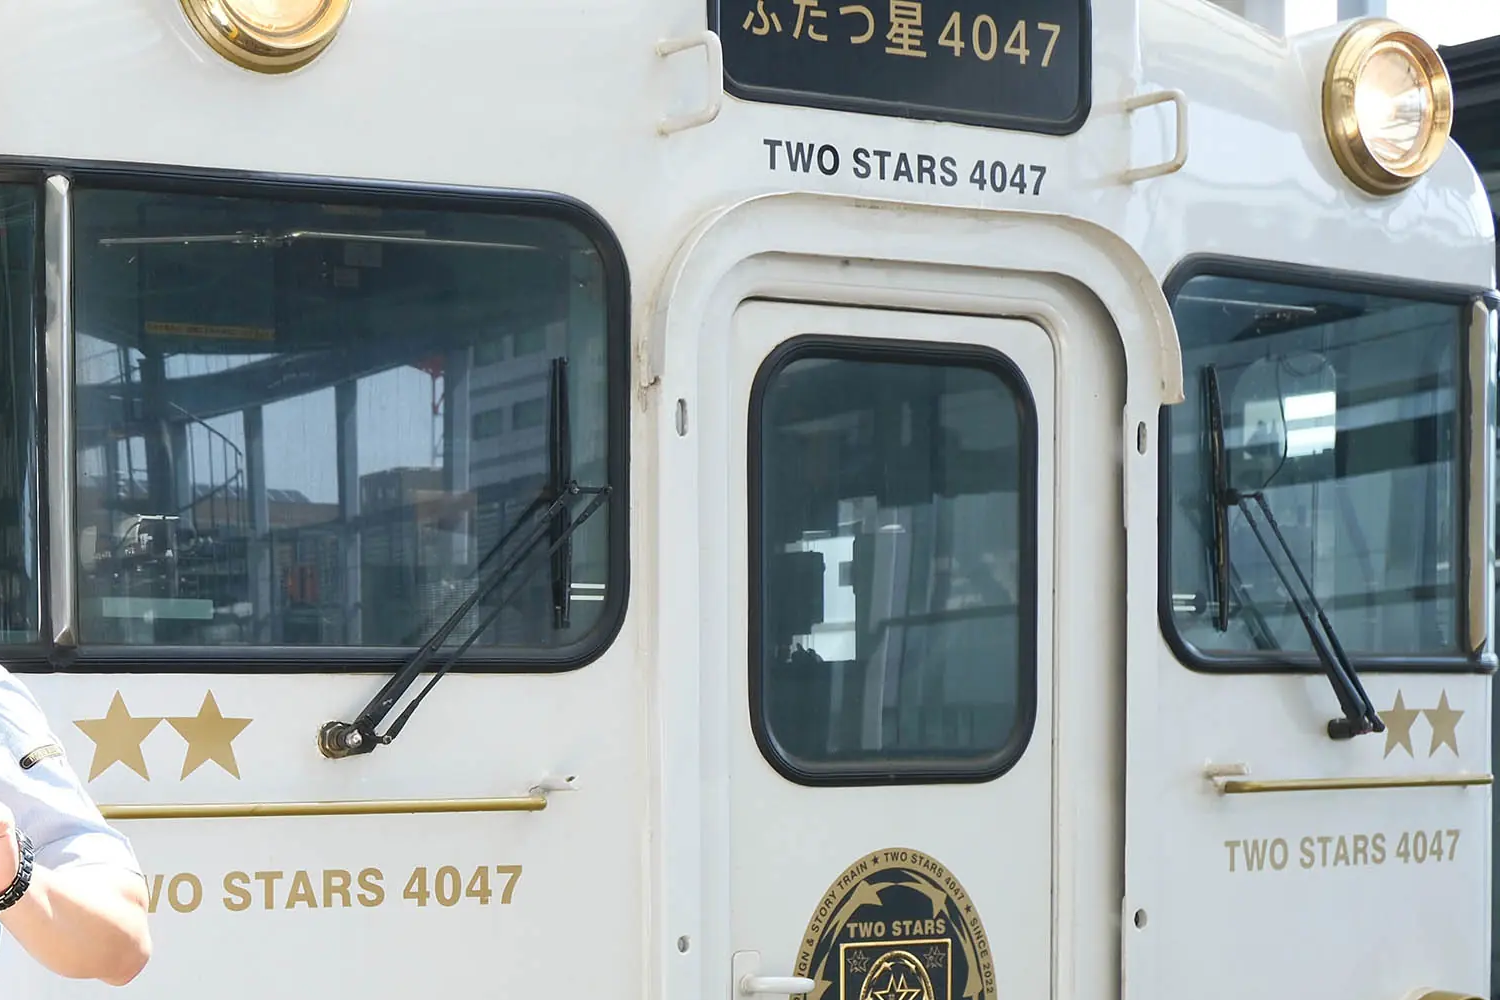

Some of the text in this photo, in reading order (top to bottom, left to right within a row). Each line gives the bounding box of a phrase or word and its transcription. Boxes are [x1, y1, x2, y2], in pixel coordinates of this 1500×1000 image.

[763, 138, 1047, 196] TWO STARS 4047
[884, 851, 966, 901] TWO STARS 4047
[1224, 829, 1460, 873] TWO STARS 4047
[222, 867, 386, 913] STARS
[402, 864, 524, 908] 4047
[806, 938, 815, 947] &
[811, 891, 838, 933] STORY
[837, 860, 869, 891] TRAIN
[846, 917, 946, 938] TWO STARS
[970, 917, 995, 993] SINCE 2022
